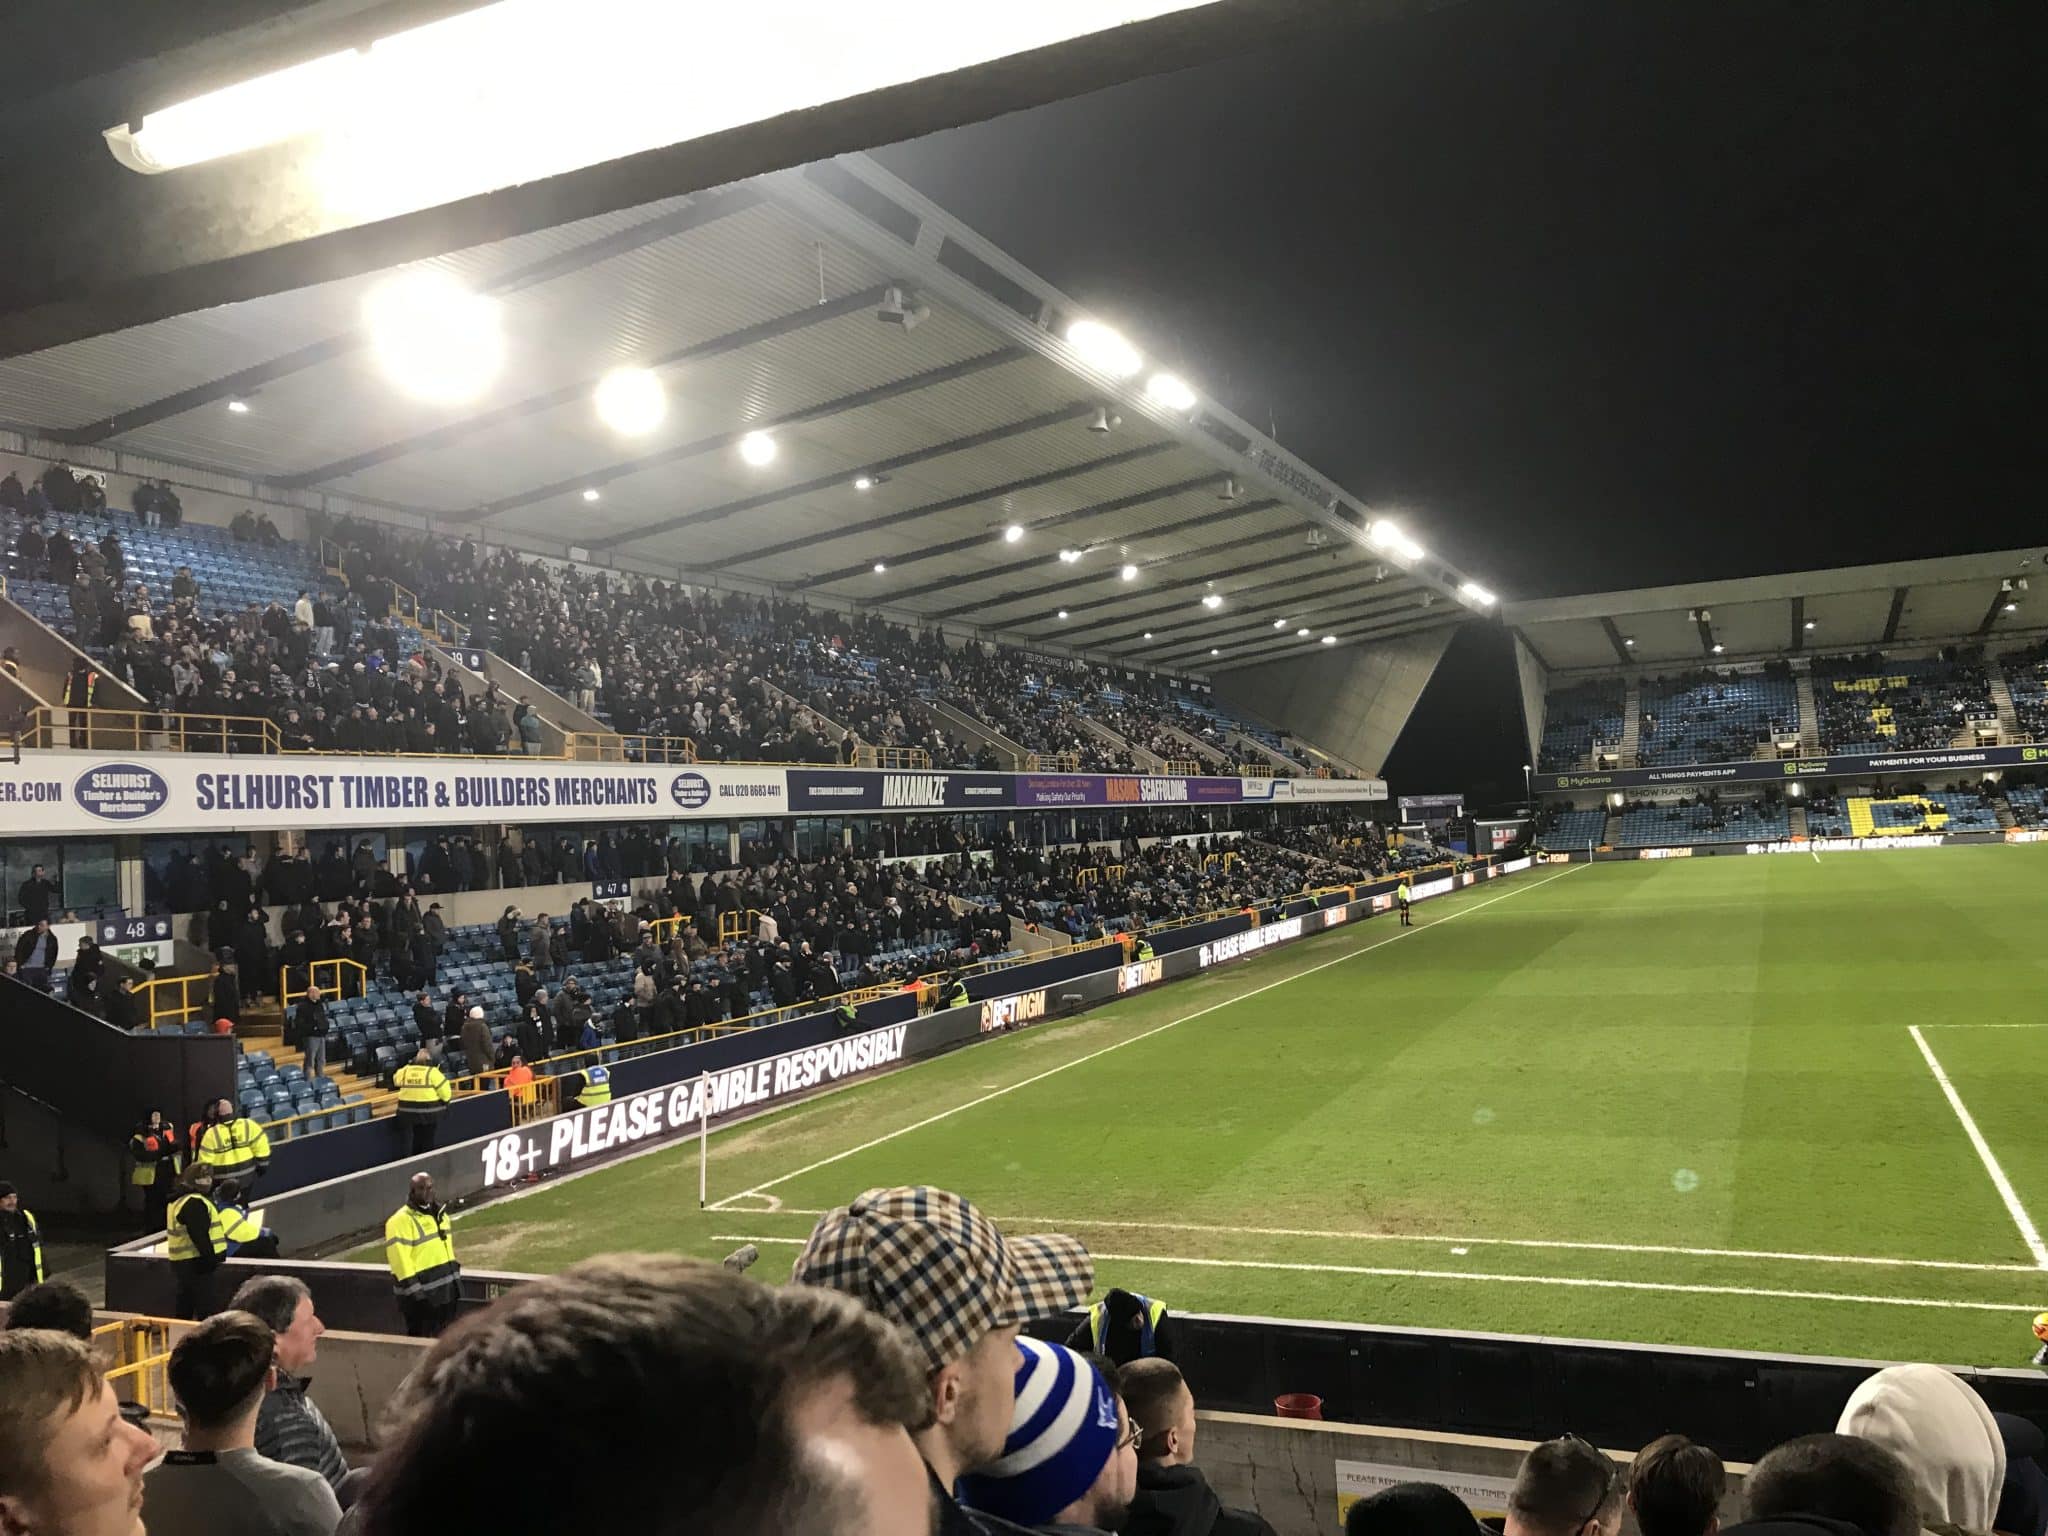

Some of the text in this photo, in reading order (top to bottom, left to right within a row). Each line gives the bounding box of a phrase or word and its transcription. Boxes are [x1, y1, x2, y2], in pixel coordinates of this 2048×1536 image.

[1869, 753, 1986, 767] PAYMENTS FOR YOUR BUSINESS
[91, 773, 152, 789] SELHURST
[1570, 776, 1612, 787] MyGuava
[1661, 771, 1686, 780] THINGS
[1686, 769, 1722, 778] PAYMENTS
[1722, 768, 1737, 776] APP
[82, 790, 115, 801] Timber
[115, 791, 123, 801] &
[195, 772, 658, 811] SELHURST TIMBER & BUILDERS MERCHANTS
[719, 784, 735, 797] CALL
[735, 785, 749, 797] 020
[767, 784, 781, 797] 4411
[882, 775, 949, 807] MAXAMAZE
[1105, 778, 1189, 802] MASONS SCAFFOLDING
[1630, 789, 1661, 798] SHOW
[1662, 788, 1698, 797] RACISM
[99, 802, 146, 813] Merchants
[1648, 847, 1693, 859] BETMGM
[1745, 843, 1767, 855] 18+
[1767, 840, 1811, 854] PLEASE
[607, 882, 617, 895] 47
[126, 922, 146, 938] 48
[1213, 935, 1240, 964] PLEASE
[1126, 958, 1163, 991] BETMGM
[992, 990, 1047, 1028] BETMGM
[481, 1025, 908, 1187] 18+ PLEASE GAMBLE RESPONSIBLY
[1346, 1473, 1377, 1485] PLEASE
[1450, 1485, 1507, 1500] AT ALL TIMES
